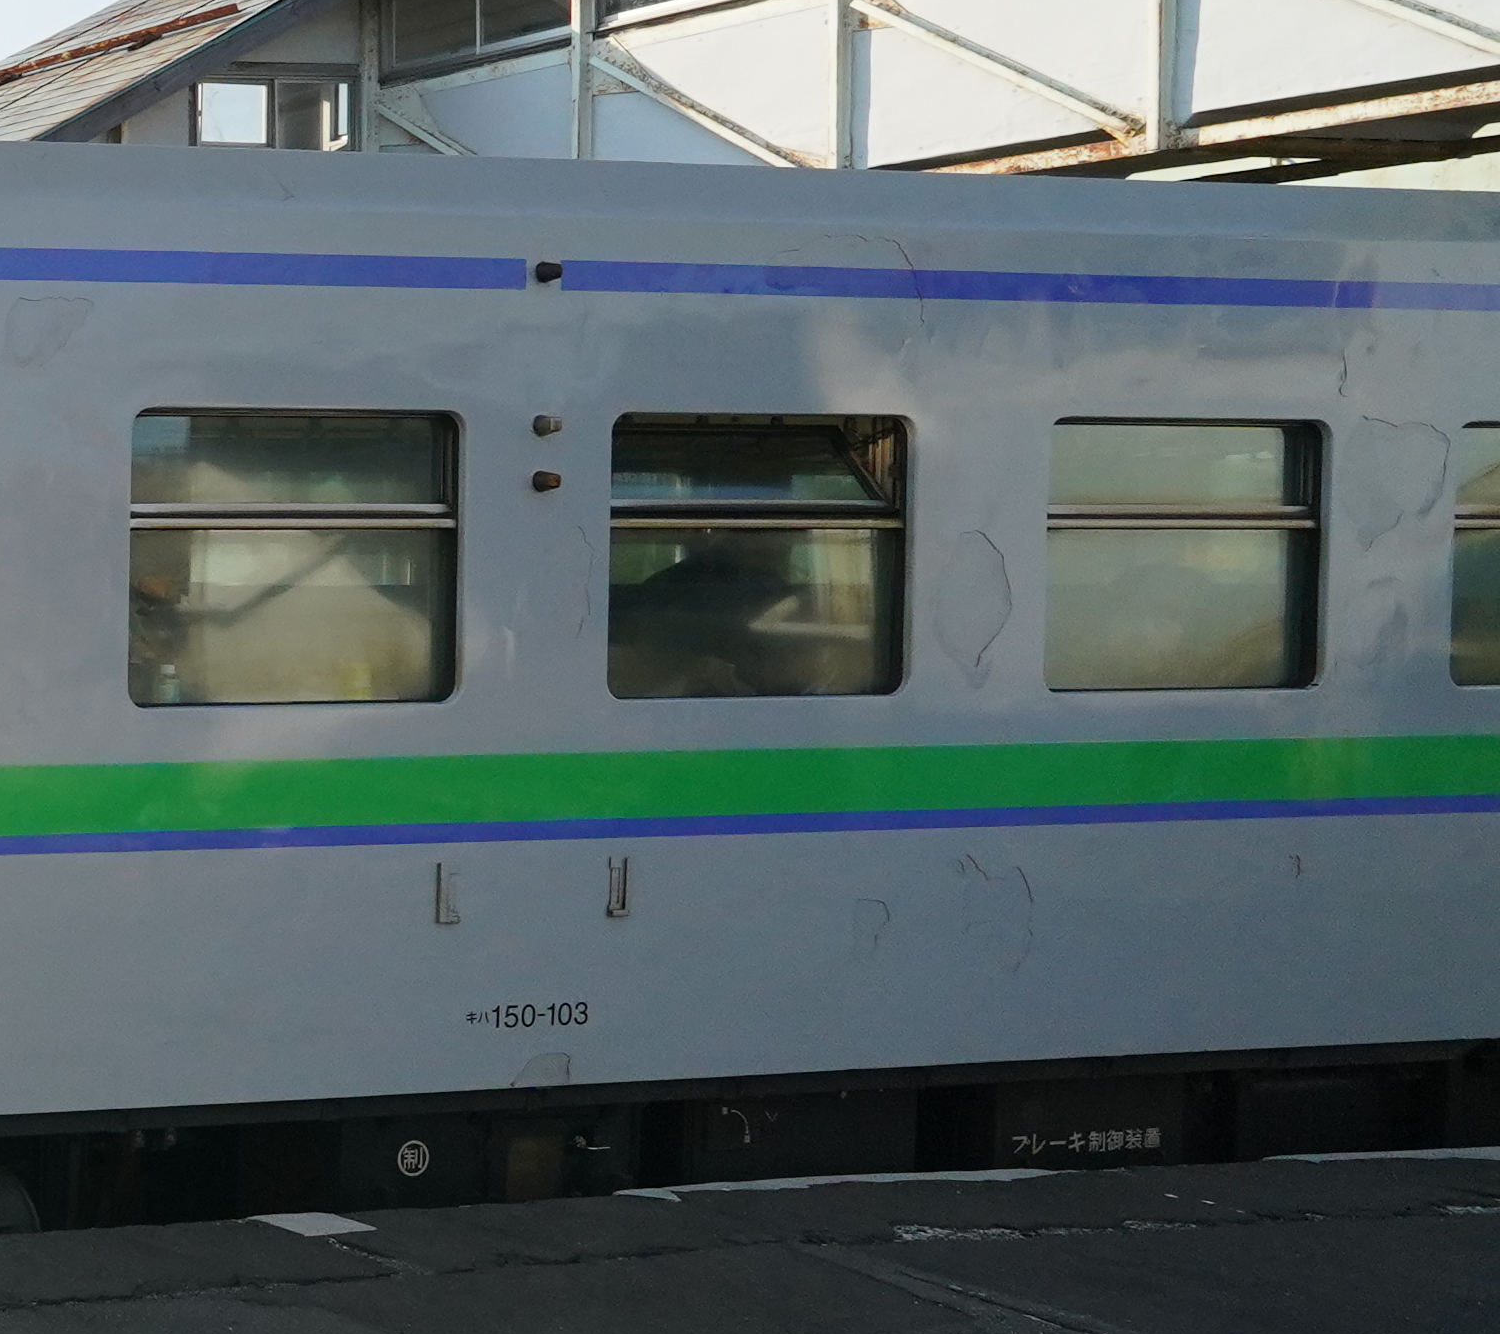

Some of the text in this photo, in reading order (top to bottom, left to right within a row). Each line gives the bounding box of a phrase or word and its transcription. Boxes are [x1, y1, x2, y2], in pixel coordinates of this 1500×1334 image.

[1012, 1127, 1163, 1155] ブレーキ制御装置
